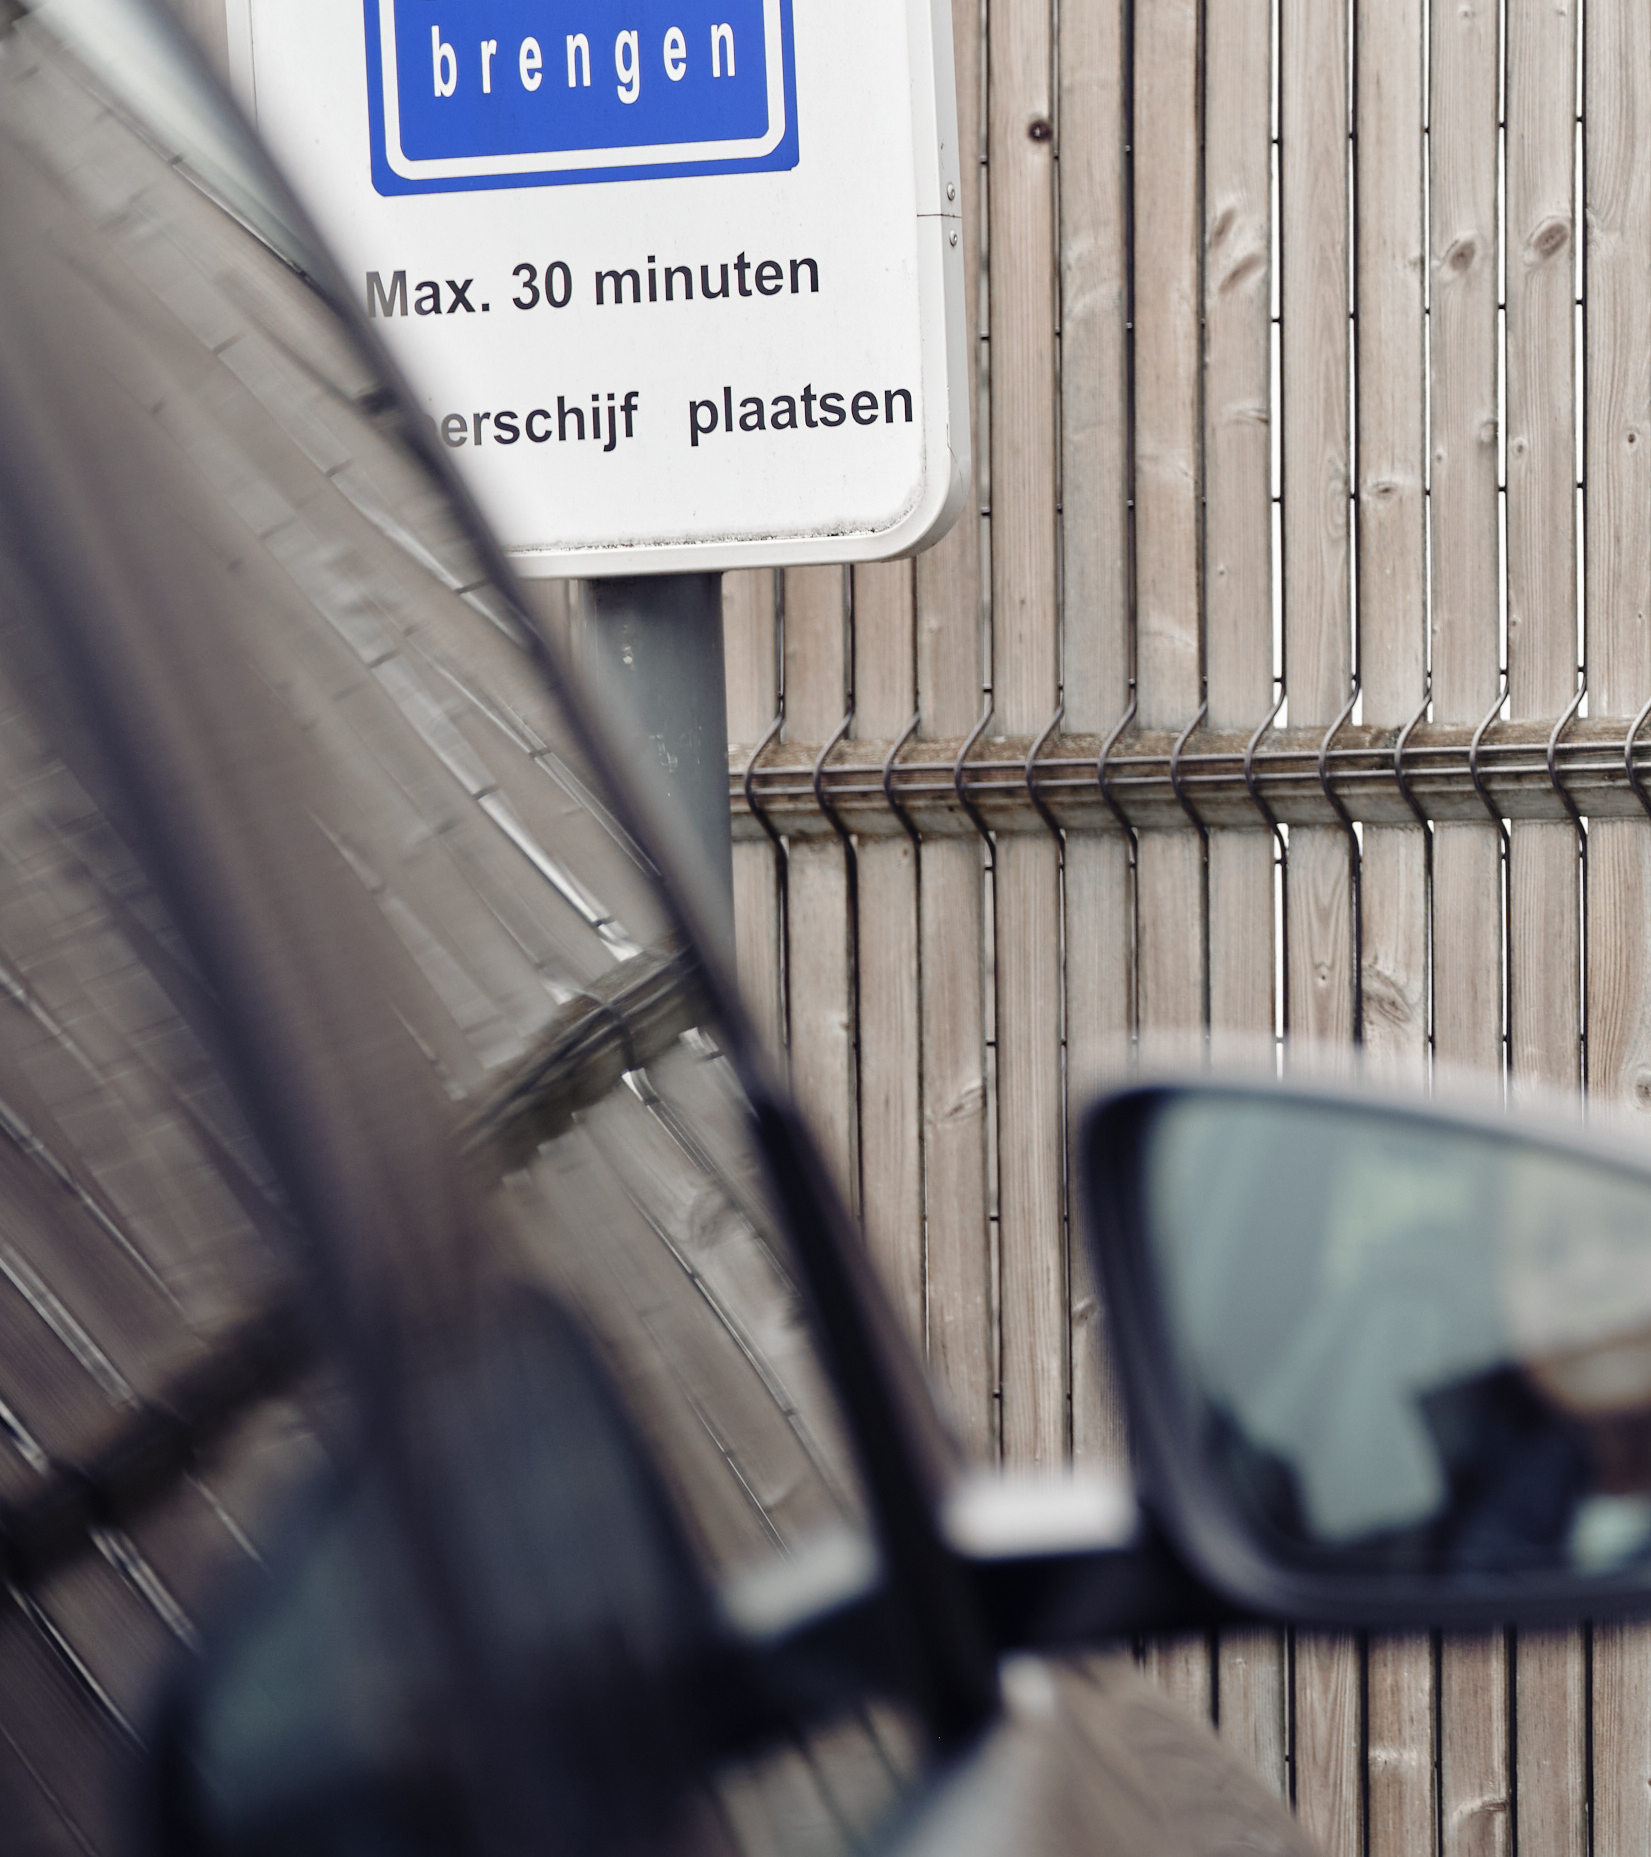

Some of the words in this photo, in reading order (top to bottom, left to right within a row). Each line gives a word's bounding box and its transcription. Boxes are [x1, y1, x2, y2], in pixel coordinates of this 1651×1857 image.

[431, 22, 736, 105] brengen
[365, 268, 491, 318] Max.
[512, 261, 573, 310] 30
[594, 251, 820, 306] minuten
[689, 384, 914, 446] plaatsen
